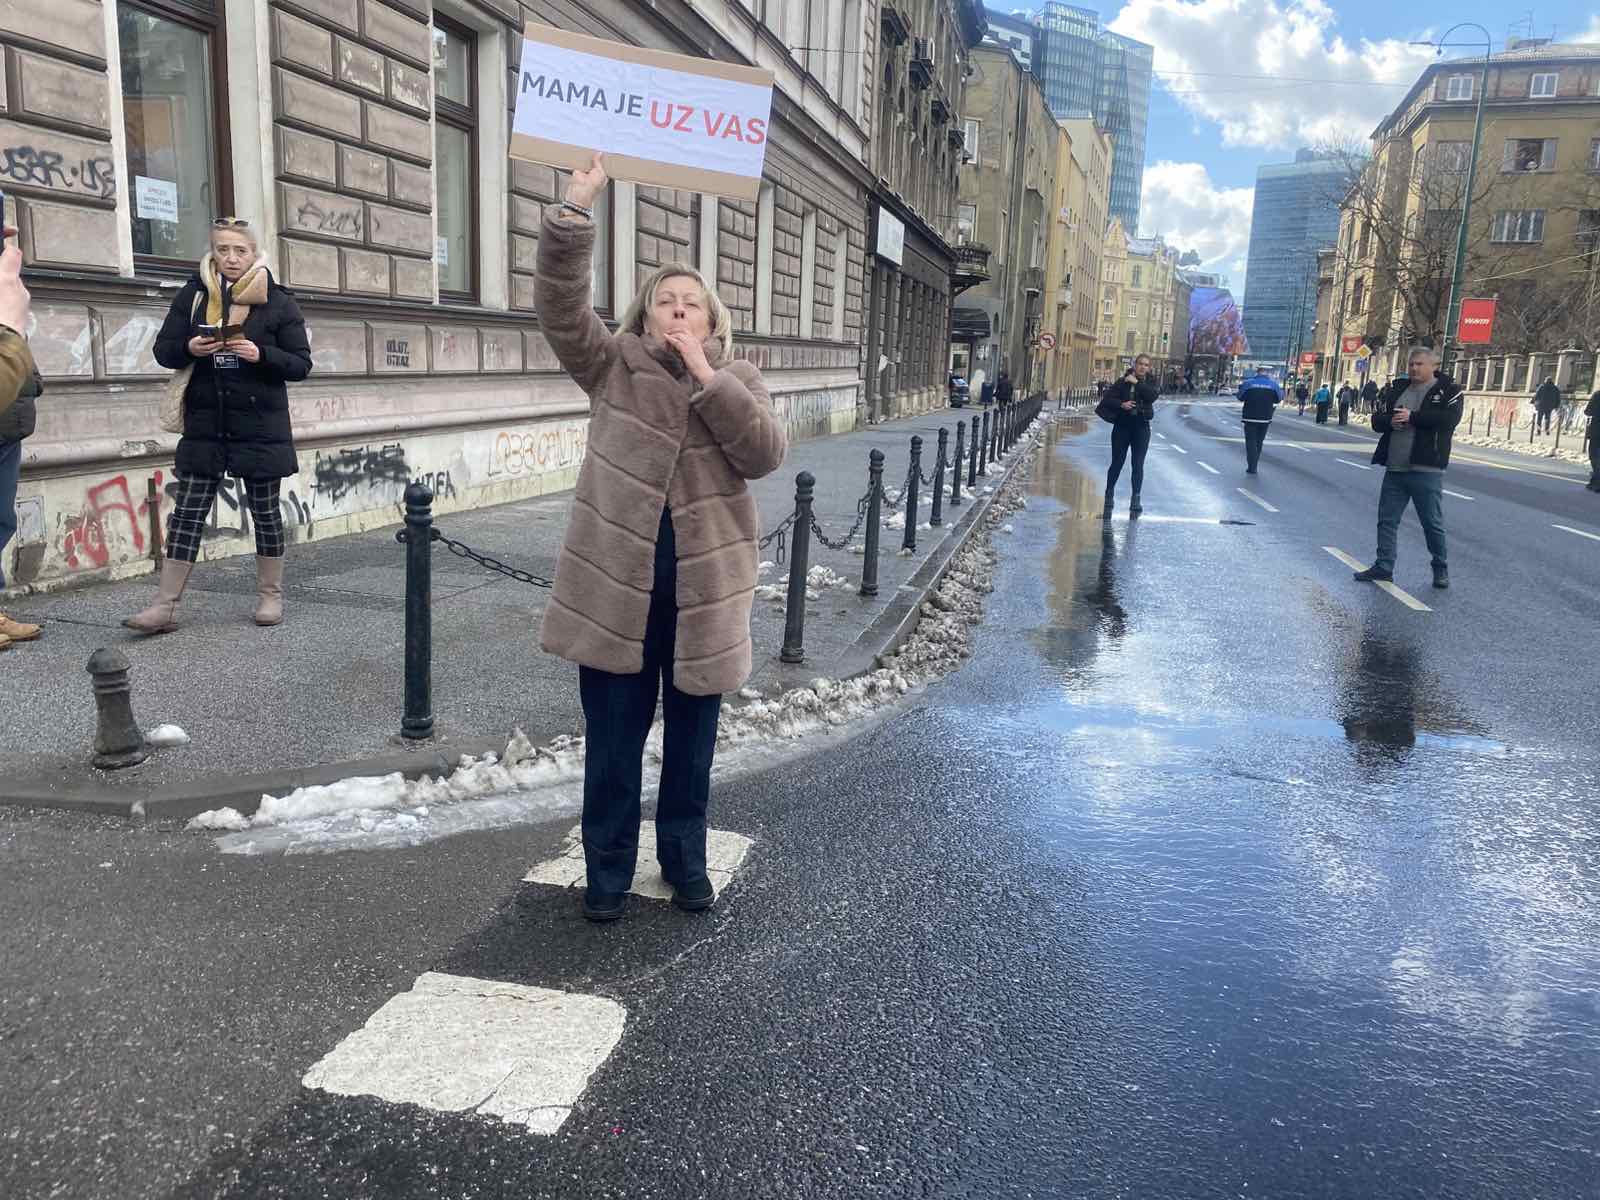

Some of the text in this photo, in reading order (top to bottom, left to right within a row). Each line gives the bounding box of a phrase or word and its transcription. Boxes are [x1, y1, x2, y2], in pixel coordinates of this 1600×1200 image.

[522, 72, 765, 144] MAMA JE UZ VAS
